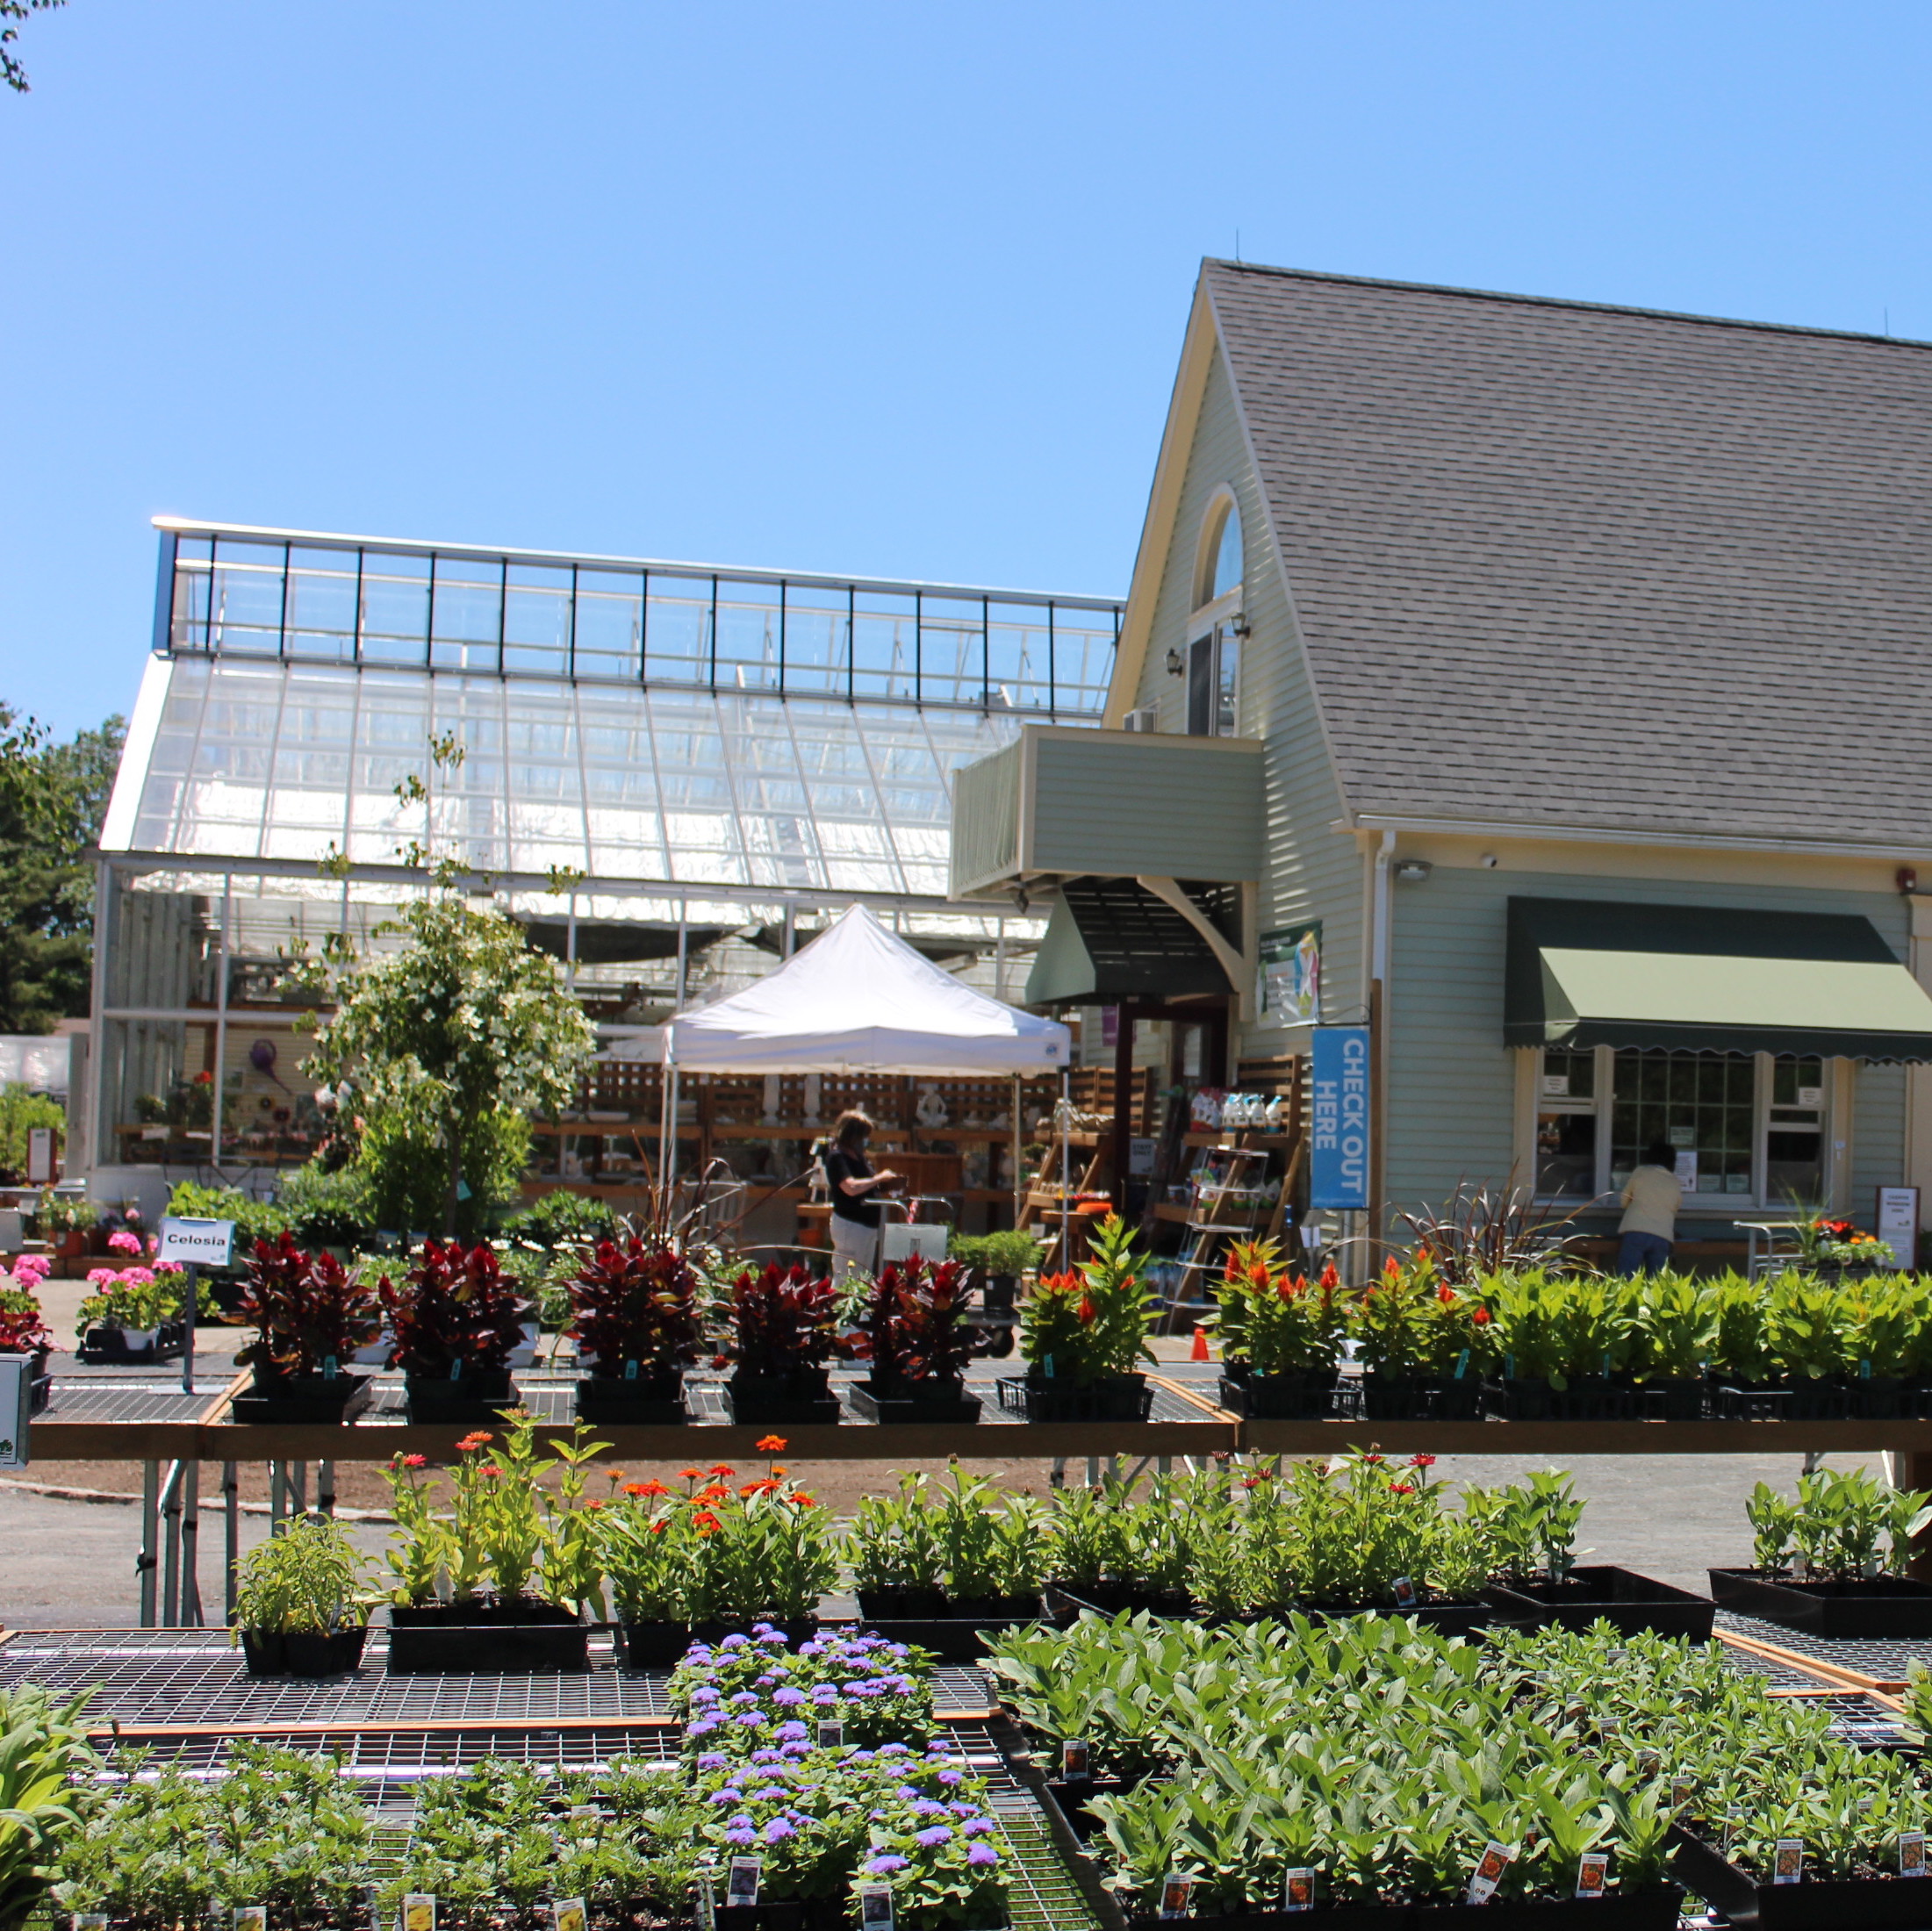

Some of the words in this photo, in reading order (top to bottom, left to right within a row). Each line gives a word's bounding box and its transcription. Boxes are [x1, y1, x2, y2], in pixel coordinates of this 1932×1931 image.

[1316, 1081, 1338, 1150] HERE
[1342, 1038, 1365, 1131] CHECK
[1340, 1136, 1363, 1194] OUT
[169, 1234, 226, 1246] Celosia
